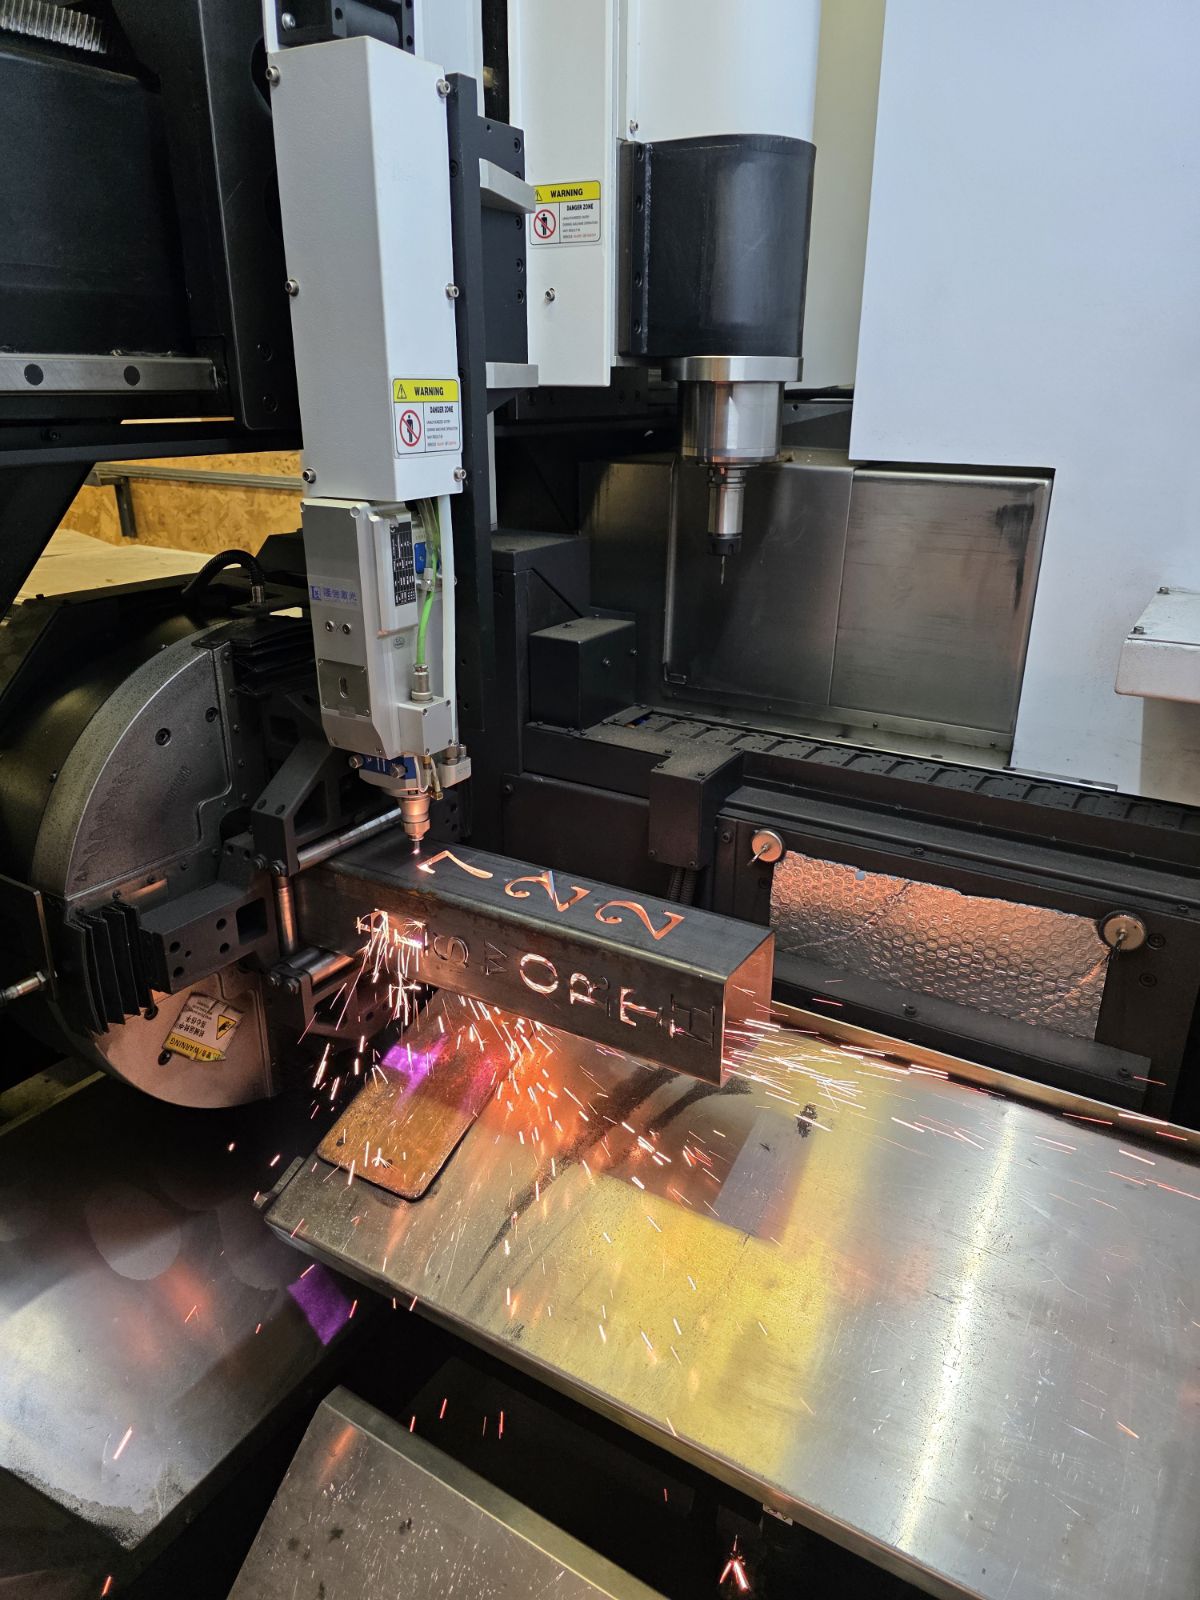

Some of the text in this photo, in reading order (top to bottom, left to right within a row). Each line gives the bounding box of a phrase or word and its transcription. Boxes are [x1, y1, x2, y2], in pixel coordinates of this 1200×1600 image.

[550, 188, 583, 198] WARNING
[566, 203, 582, 211] DANGER
[414, 386, 444, 396] WARNING
[430, 405, 453, 414] DANGER ZONE
